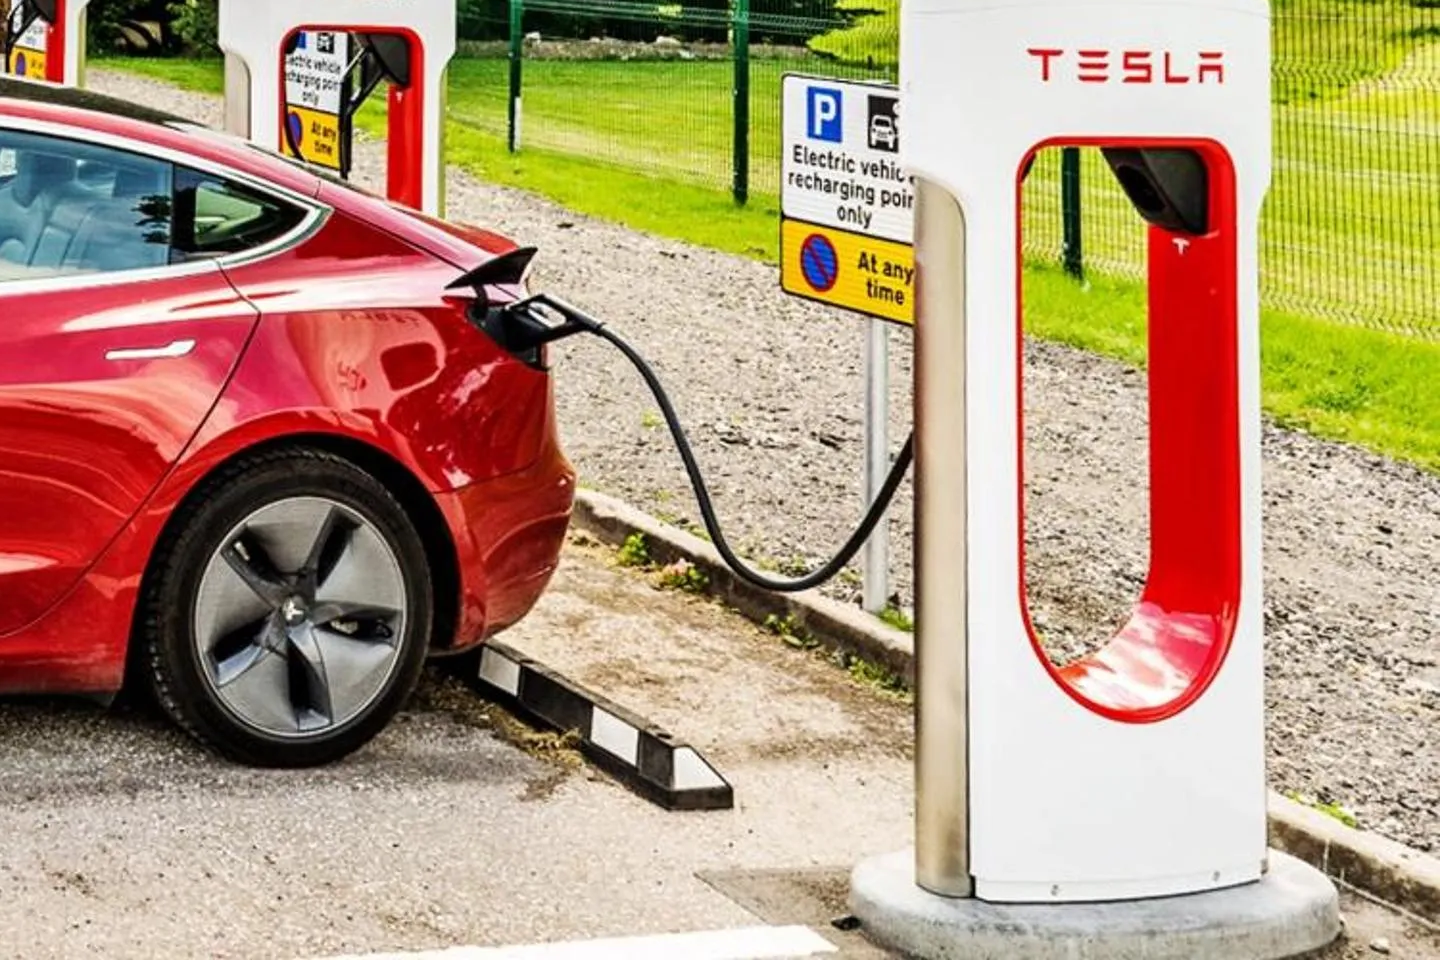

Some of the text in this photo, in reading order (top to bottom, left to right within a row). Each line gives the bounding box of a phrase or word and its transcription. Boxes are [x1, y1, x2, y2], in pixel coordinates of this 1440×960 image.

[1027, 48, 1224, 84] TESLA
[792, 144, 856, 174] Electric
[788, 171, 875, 206] recharging
[836, 205, 873, 230] only
[857, 251, 914, 287] At any
[866, 279, 905, 306] time
